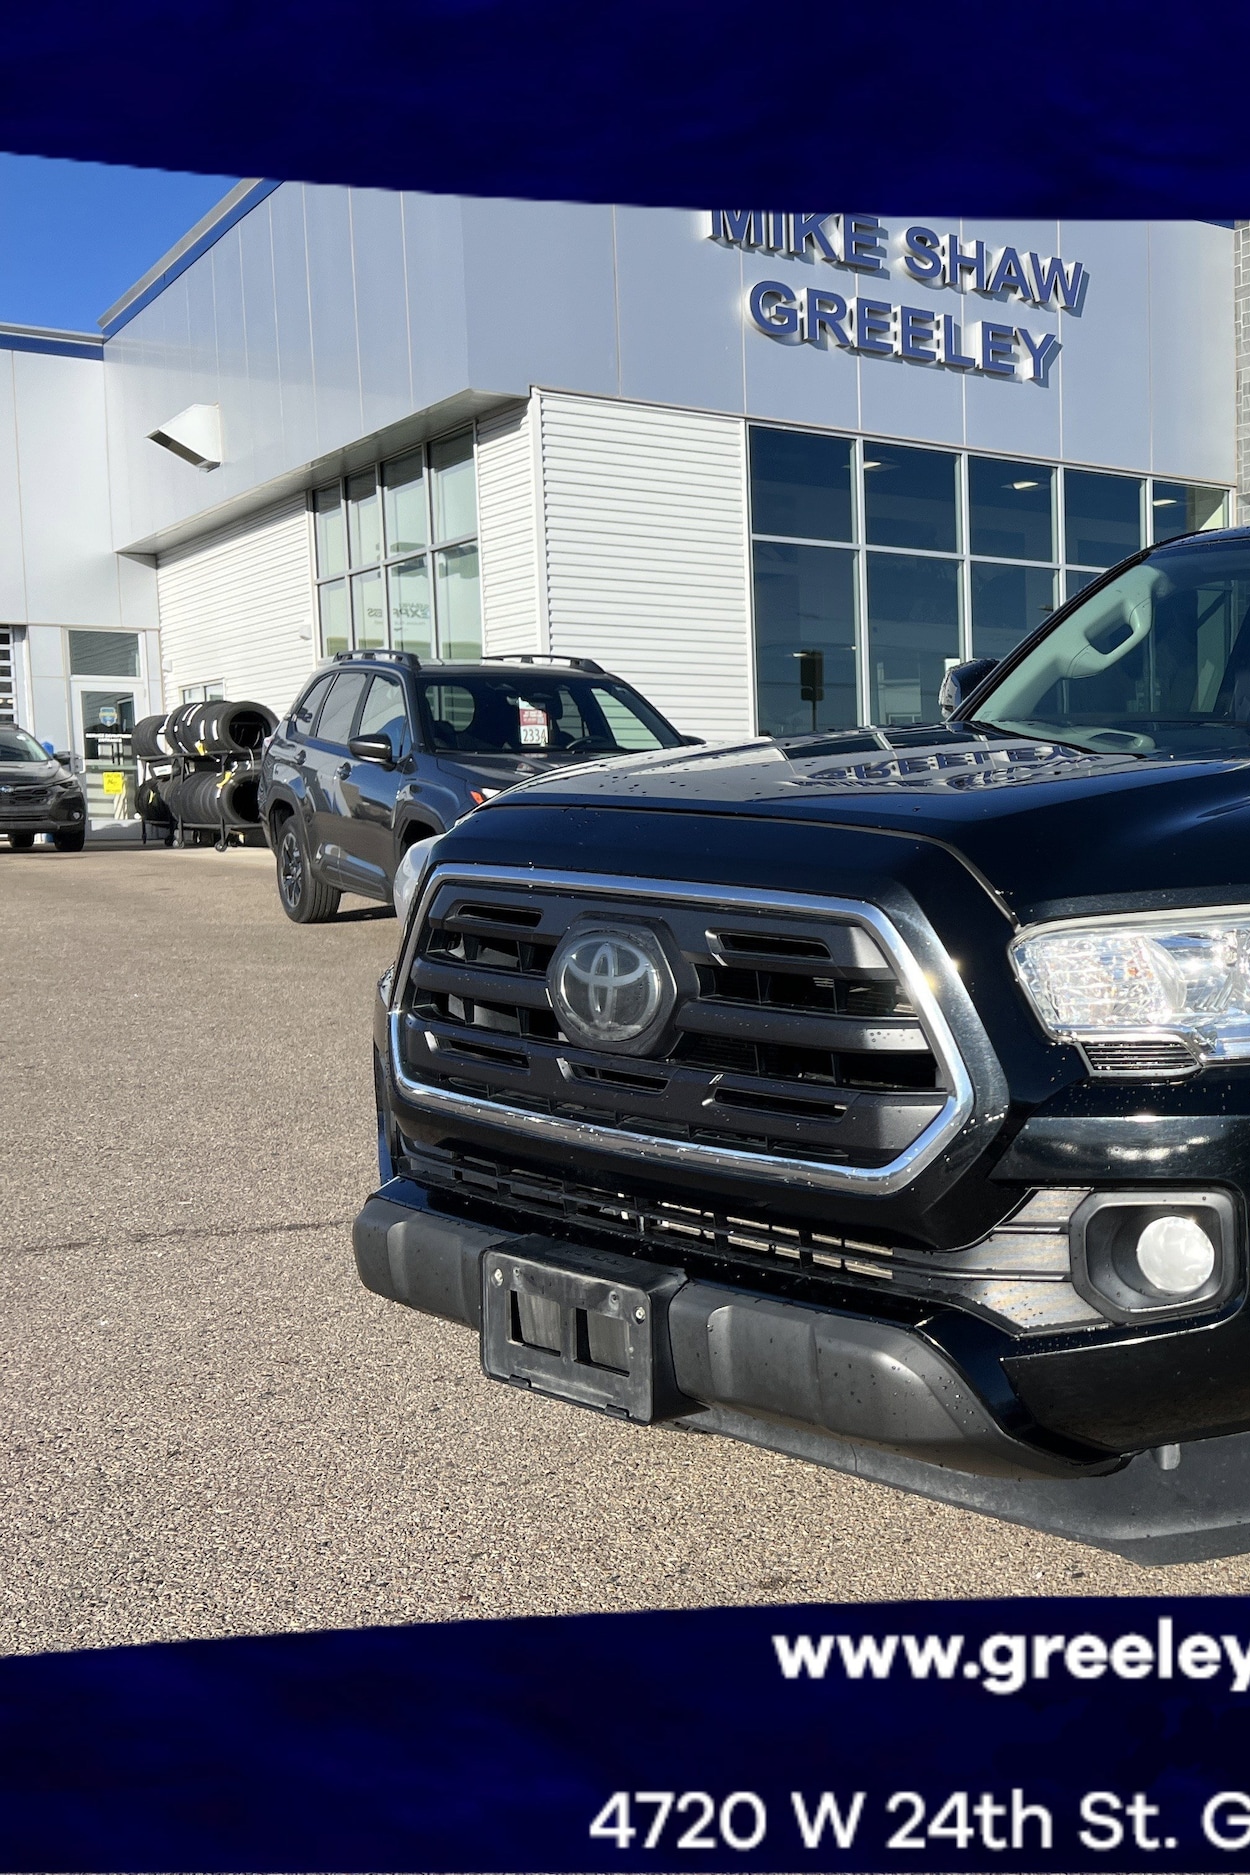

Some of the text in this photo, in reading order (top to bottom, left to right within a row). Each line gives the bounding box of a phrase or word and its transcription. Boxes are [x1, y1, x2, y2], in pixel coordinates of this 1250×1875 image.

[709, 210, 1084, 310] MIKE SHAW
[748, 280, 1057, 380] GREELEY
[522, 728, 546, 743] 2334
